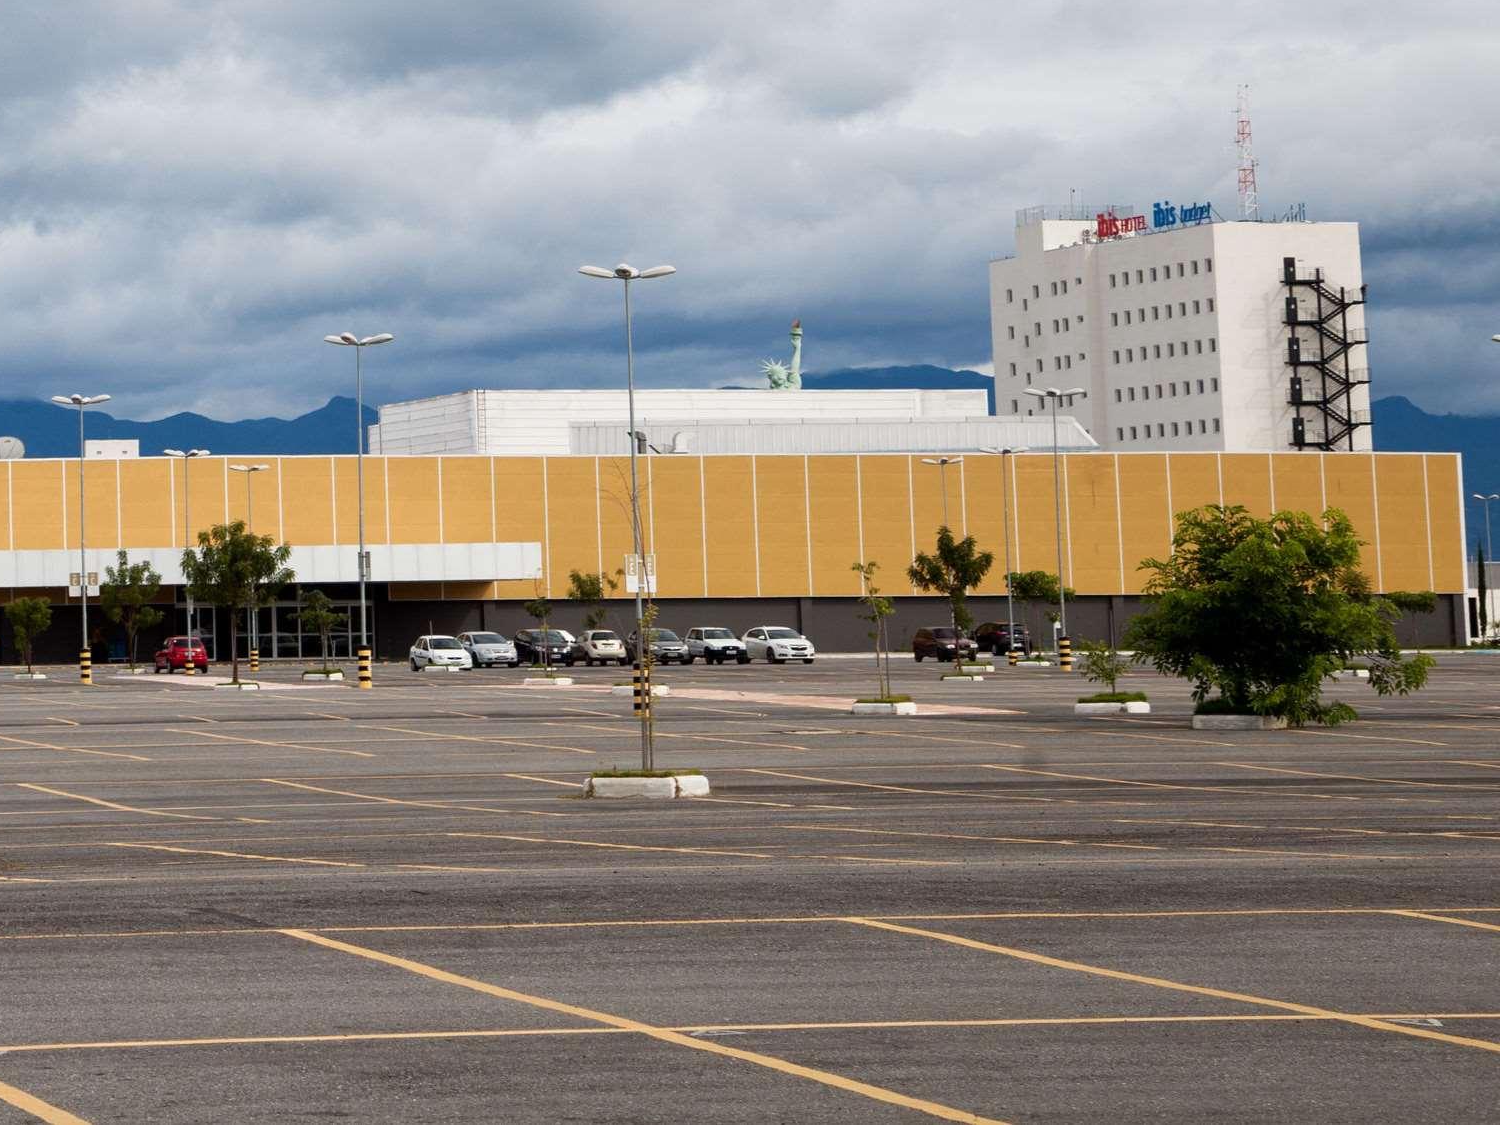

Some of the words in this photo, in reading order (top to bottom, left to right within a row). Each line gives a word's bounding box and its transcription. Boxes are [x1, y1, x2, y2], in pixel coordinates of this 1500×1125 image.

[1097, 210, 1120, 237] ibis
[1120, 215, 1146, 234] HOTEL
[1153, 201, 1176, 227] ibis
[1180, 201, 1211, 225] budget
